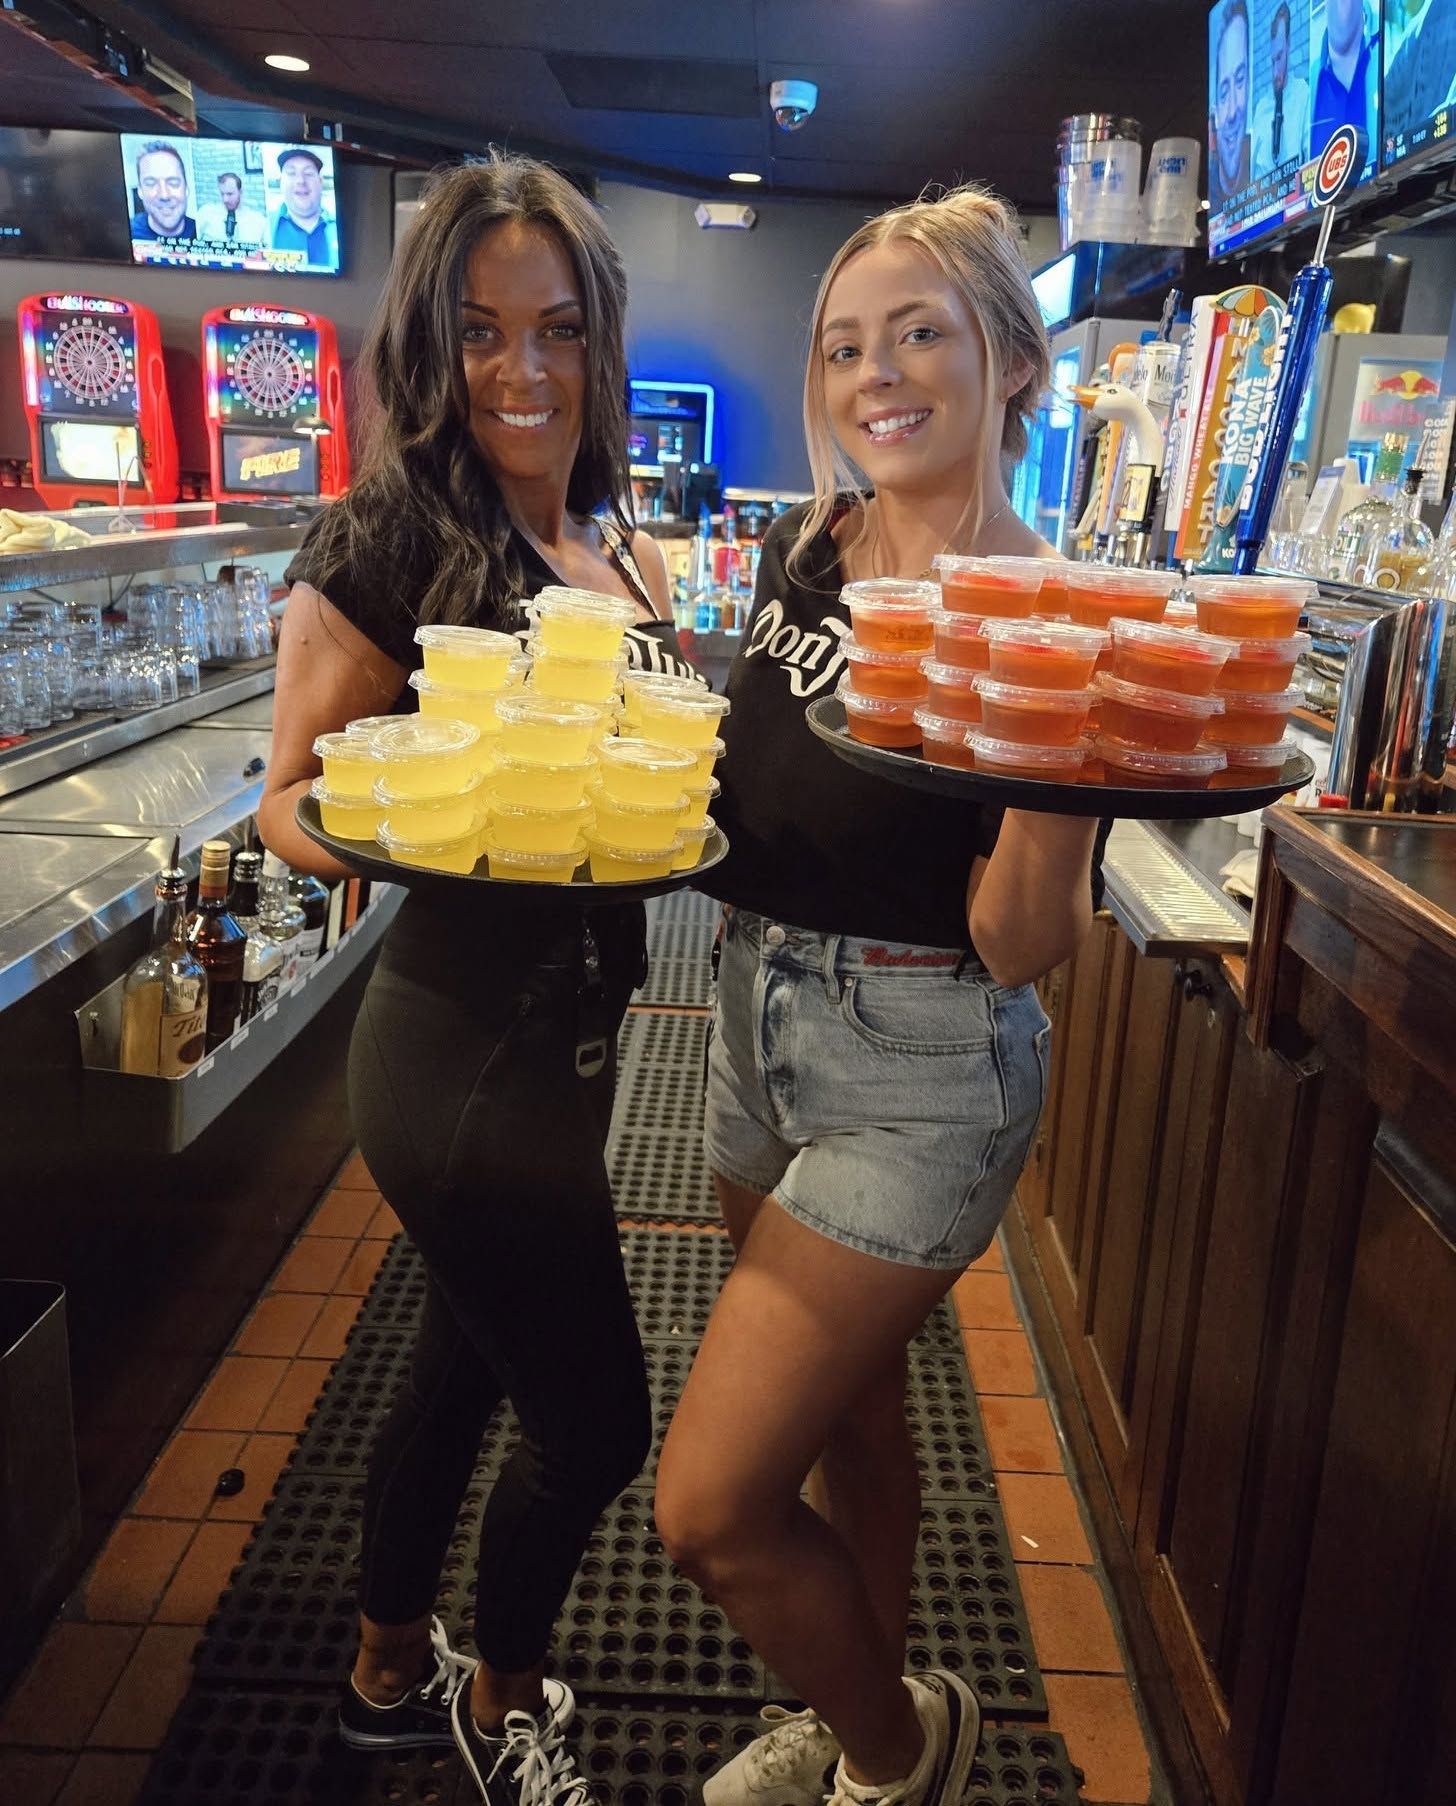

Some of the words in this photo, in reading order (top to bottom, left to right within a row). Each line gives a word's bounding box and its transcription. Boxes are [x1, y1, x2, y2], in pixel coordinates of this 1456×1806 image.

[1221, 378, 1253, 464] KONA
[1242, 376, 1268, 430] WAVE
[1234, 432, 1256, 465] BIG
[1239, 429, 1265, 511] BUD
[1183, 464, 1200, 510] MANGO
